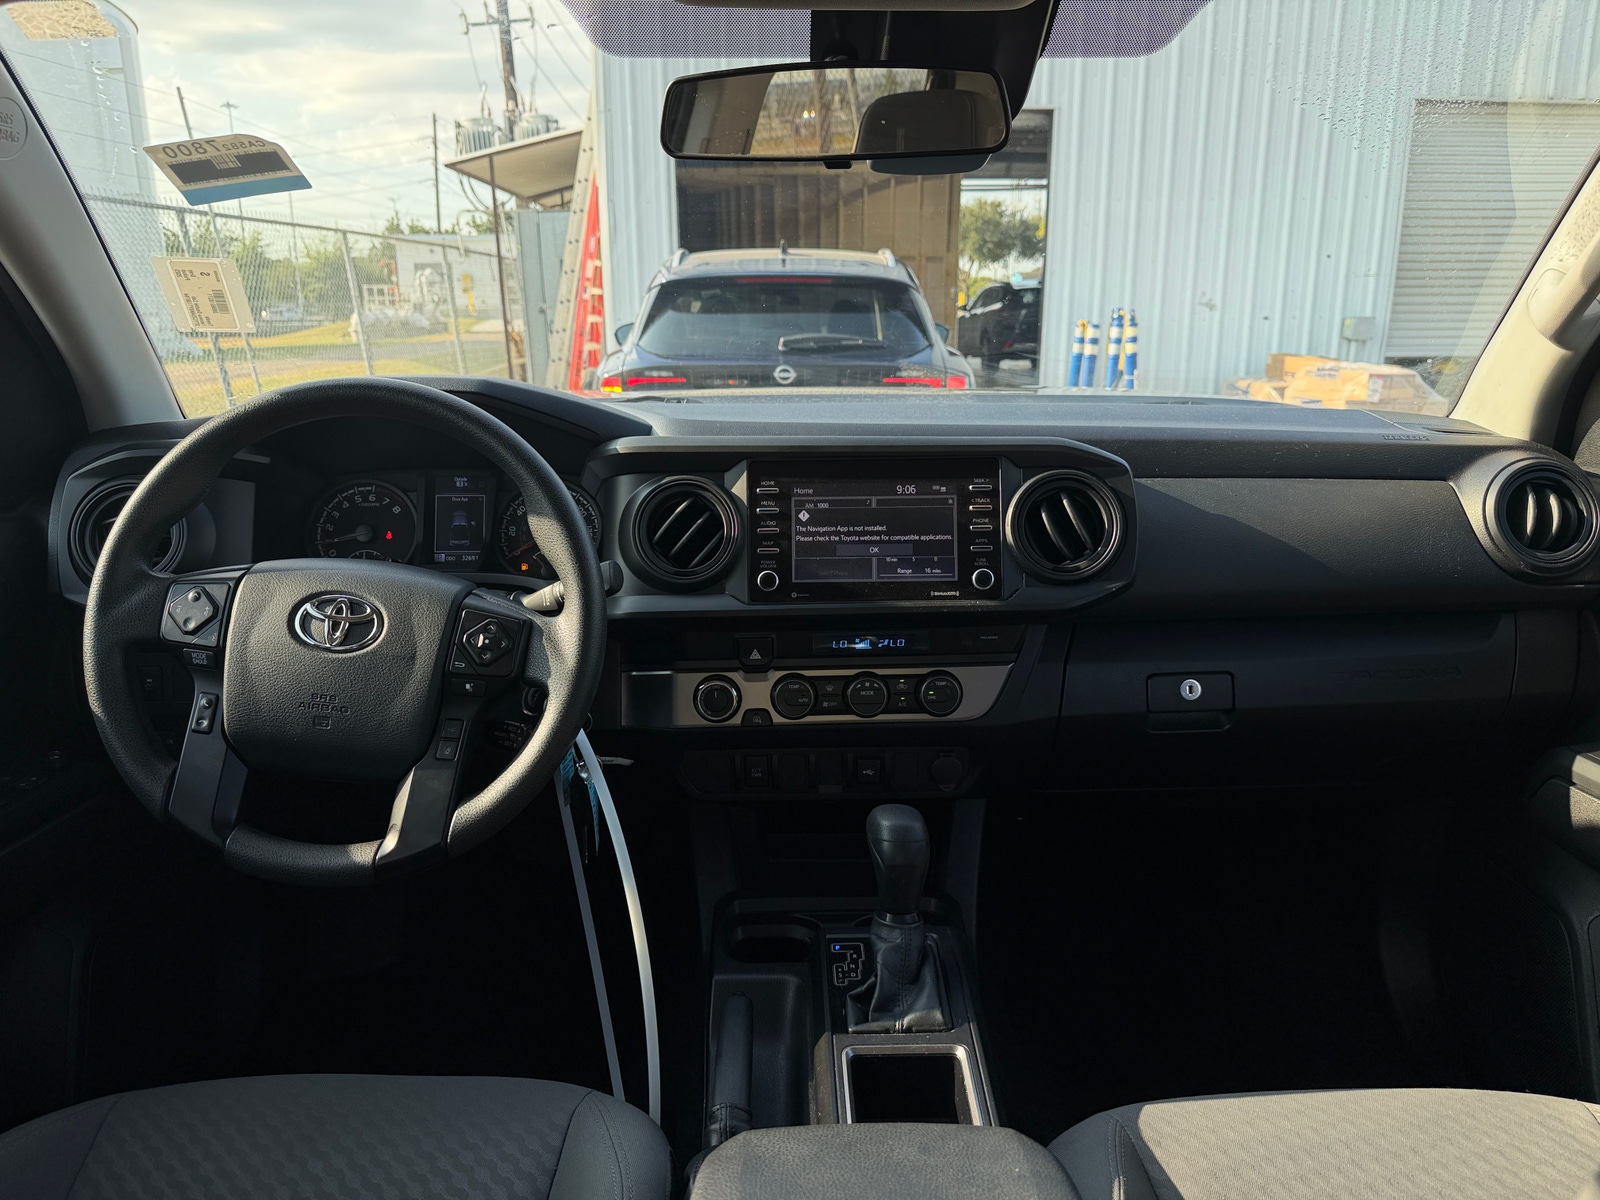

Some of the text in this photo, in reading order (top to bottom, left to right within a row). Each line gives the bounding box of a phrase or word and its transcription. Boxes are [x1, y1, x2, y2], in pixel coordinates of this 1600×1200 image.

[896, 485, 916, 494] 9:06
[354, 494, 362, 503] 5
[382, 497, 390, 505] 7
[332, 510, 340, 519] 3
[392, 506, 402, 514] 8
[516, 506, 526, 516] 40
[509, 526, 516, 537] 20
[298, 701, 350, 714] AIRBAG
